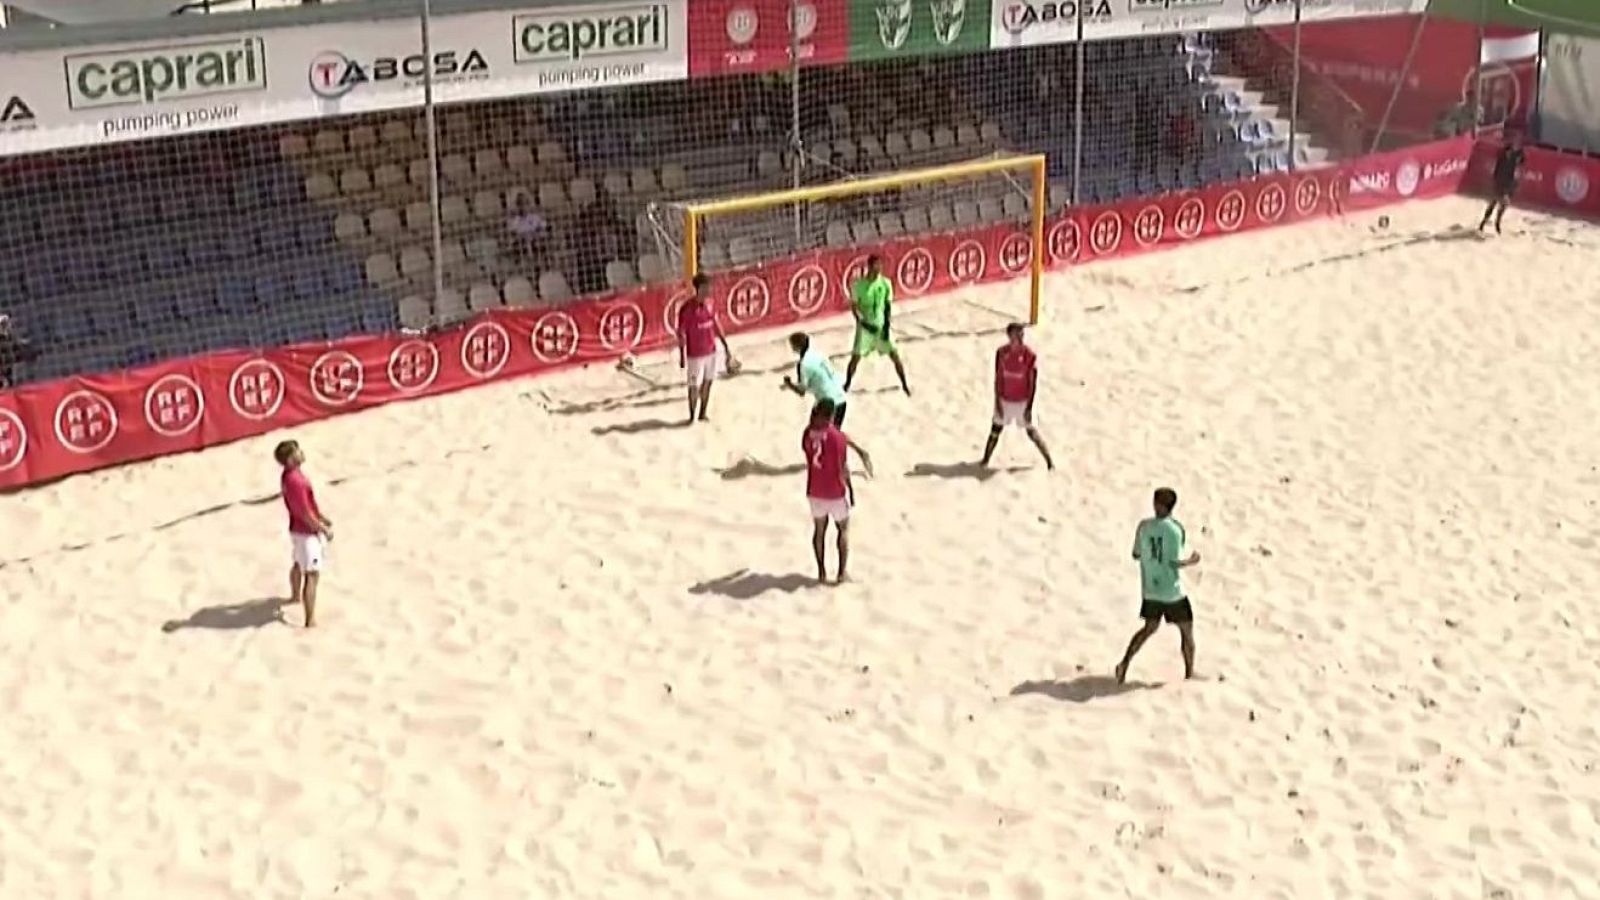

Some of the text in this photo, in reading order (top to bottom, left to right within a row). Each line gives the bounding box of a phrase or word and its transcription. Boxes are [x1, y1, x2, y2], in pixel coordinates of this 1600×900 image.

[1007, 0, 1112, 24] TABOSA
[521, 5, 660, 60] caprari
[77, 37, 257, 101] caprari
[317, 48, 489, 86] TABOSA
[538, 62, 645, 87] pumping power
[103, 105, 240, 137] pumping power
[811, 440, 822, 469] 2
